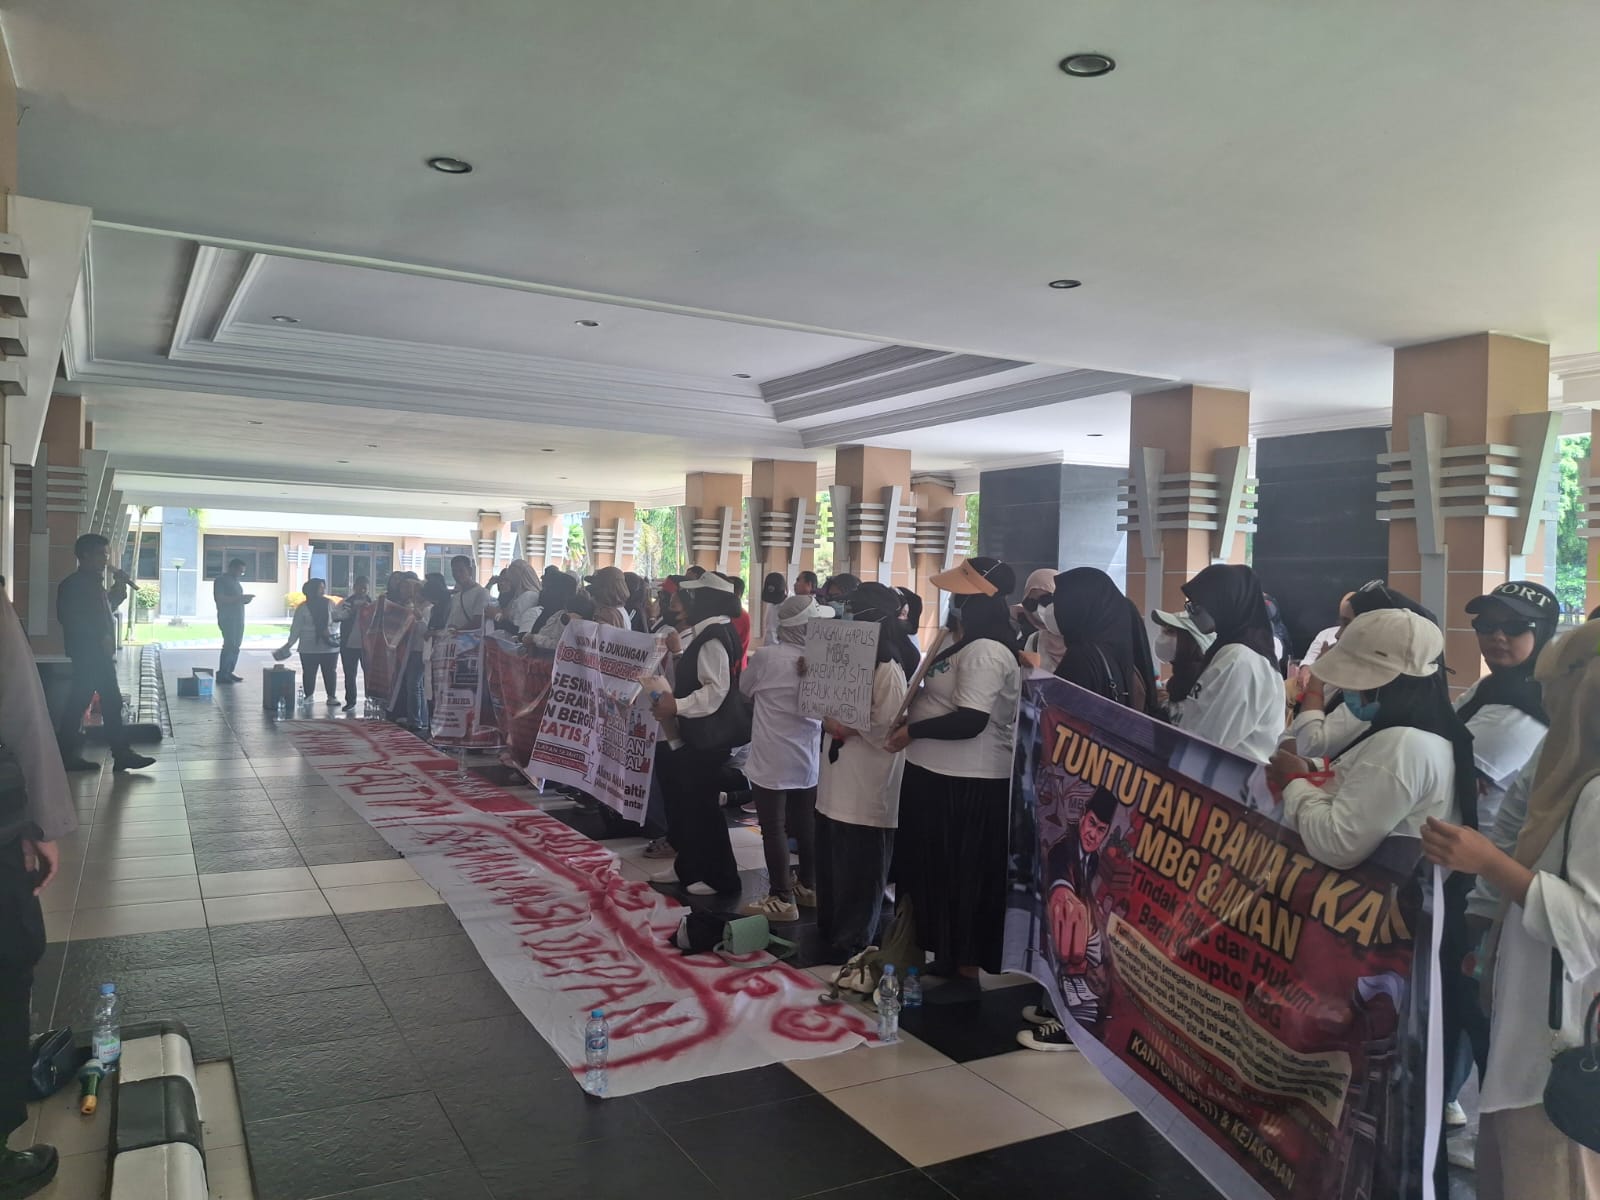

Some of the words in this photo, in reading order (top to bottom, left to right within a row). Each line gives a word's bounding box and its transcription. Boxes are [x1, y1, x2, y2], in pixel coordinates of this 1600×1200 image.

[1498, 583, 1551, 608] ORT
[605, 641, 649, 664] DUKUNGAN
[808, 622, 844, 641] JANGAN
[845, 628, 875, 648] HAPUS
[825, 643, 850, 667] MBG
[1051, 723, 1202, 840] TUNTUTAN
[1199, 804, 1314, 903] RAKYAT
[1069, 797, 1087, 810] MB
[1135, 821, 1201, 891] MBG
[1197, 862, 1221, 906] &
[1211, 879, 1303, 962] AMAN
[1131, 864, 1180, 915] Tindak
[1250, 950, 1315, 1014] Hukum
[520, 931, 693, 1040] DEPAN
[1130, 1036, 1177, 1090] KANTOR
[1219, 1112, 1231, 1129] &
[1230, 1120, 1296, 1191] KEJAKSAAN
